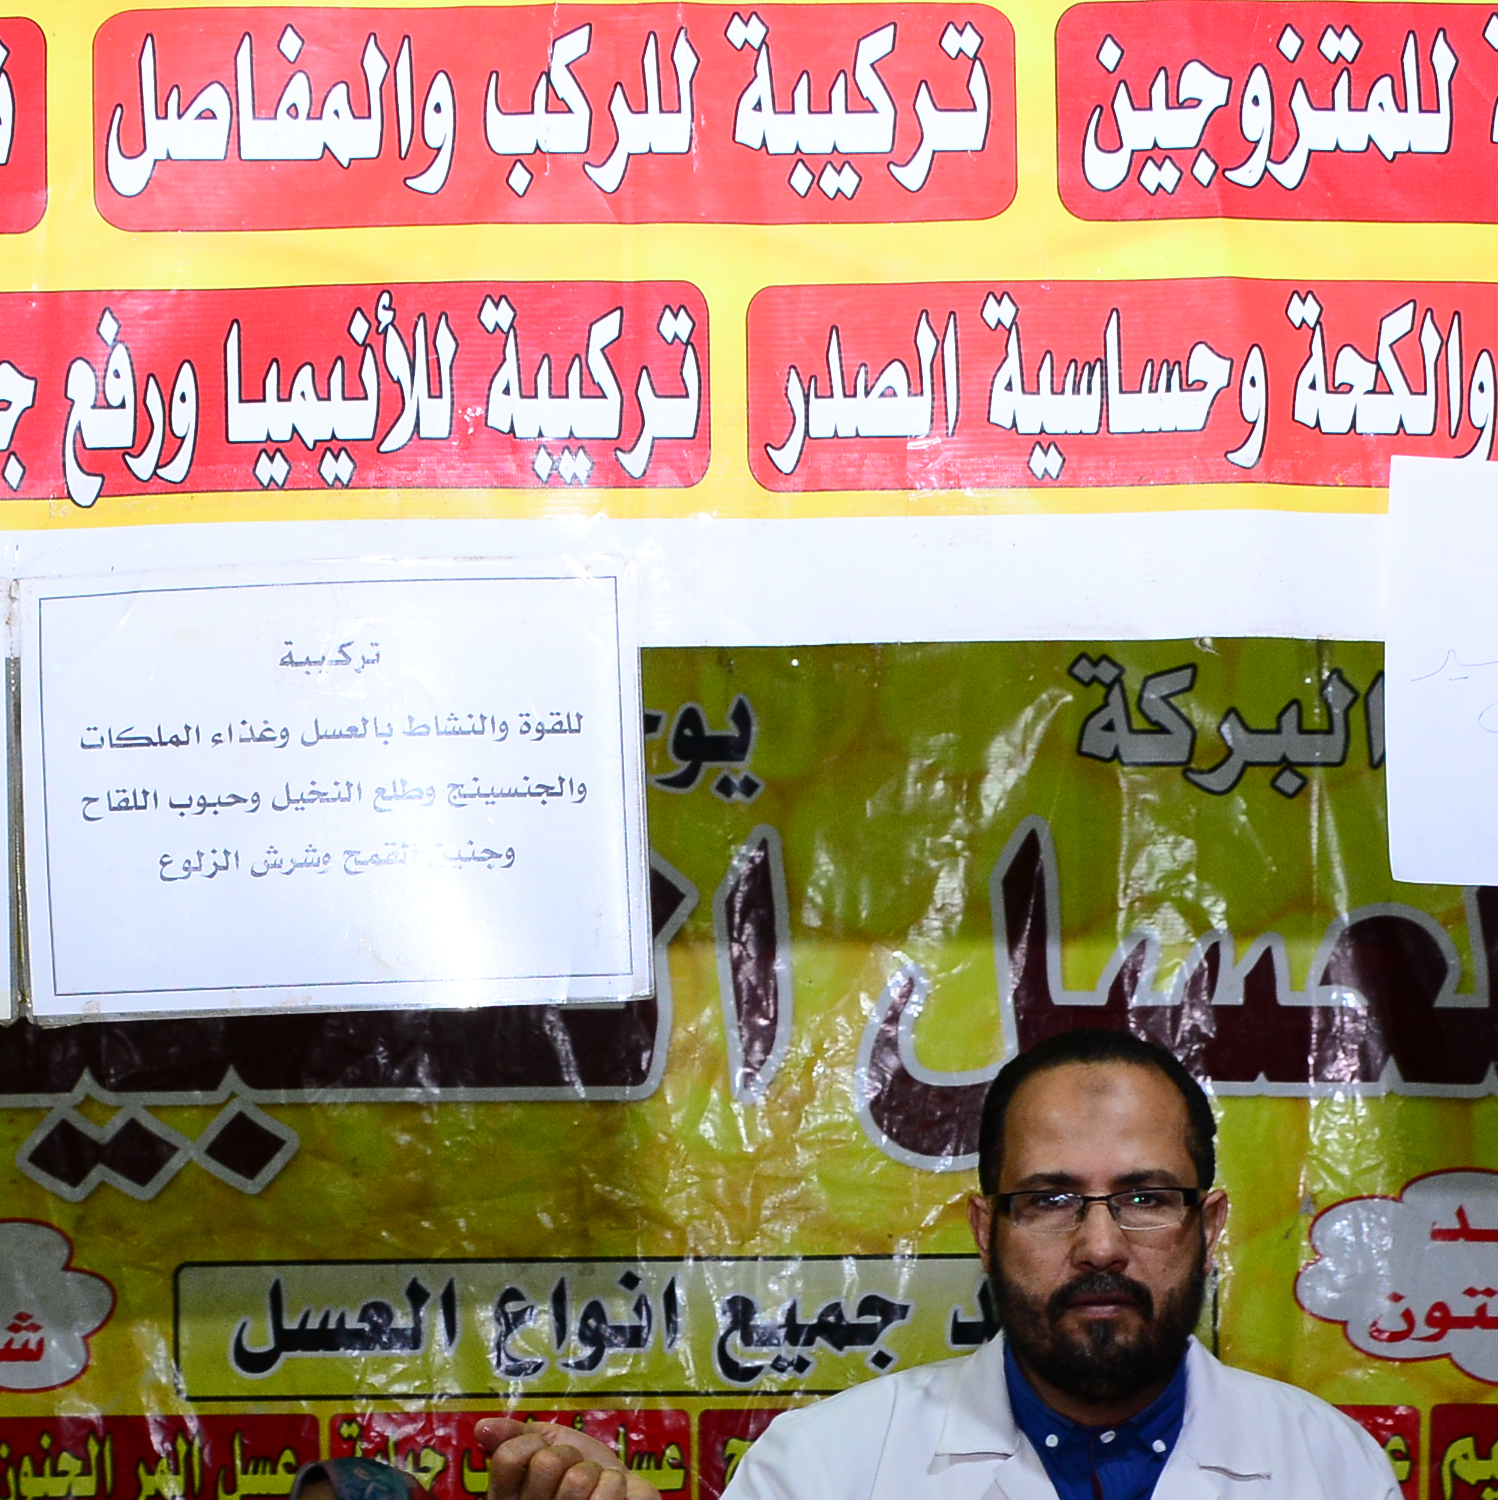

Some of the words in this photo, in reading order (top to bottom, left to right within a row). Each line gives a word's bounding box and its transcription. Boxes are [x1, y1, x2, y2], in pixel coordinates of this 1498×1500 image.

[106, 24, 456, 197] والمفاصل
[484, 23, 700, 198] للركب
[724, 11, 993, 200] تركيبة
[1081, 24, 1458, 194] للمتزوجين
[63, 307, 198, 506] ورفع
[225, 290, 458, 487] للأنيميا
[479, 293, 702, 485] تركيبة
[765, 308, 959, 475] الصدر
[982, 290, 1269, 479] وحساسية
[1285, 290, 1495, 461] والكحة
[279, 640, 381, 675] تركيبة
[80, 723, 201, 750] الملكات
[211, 719, 290, 749] وغذاء
[300, 716, 394, 747] بالعسل
[402, 712, 510, 742] والنشاط
[518, 711, 584, 742] للقوة
[1069, 652, 1387, 797] البركة
[81, 789, 158, 822] اللقاح
[168, 790, 261, 817] وحبوب
[271, 780, 363, 812] النخيل
[373, 778, 436, 813] وطلع
[447, 774, 588, 808] والجنسينج
[158, 849, 240, 881] الزلوع
[229, 1273, 458, 1378] العسل
[492, 1270, 682, 1380] انواع
[714, 1281, 912, 1384] جميع
